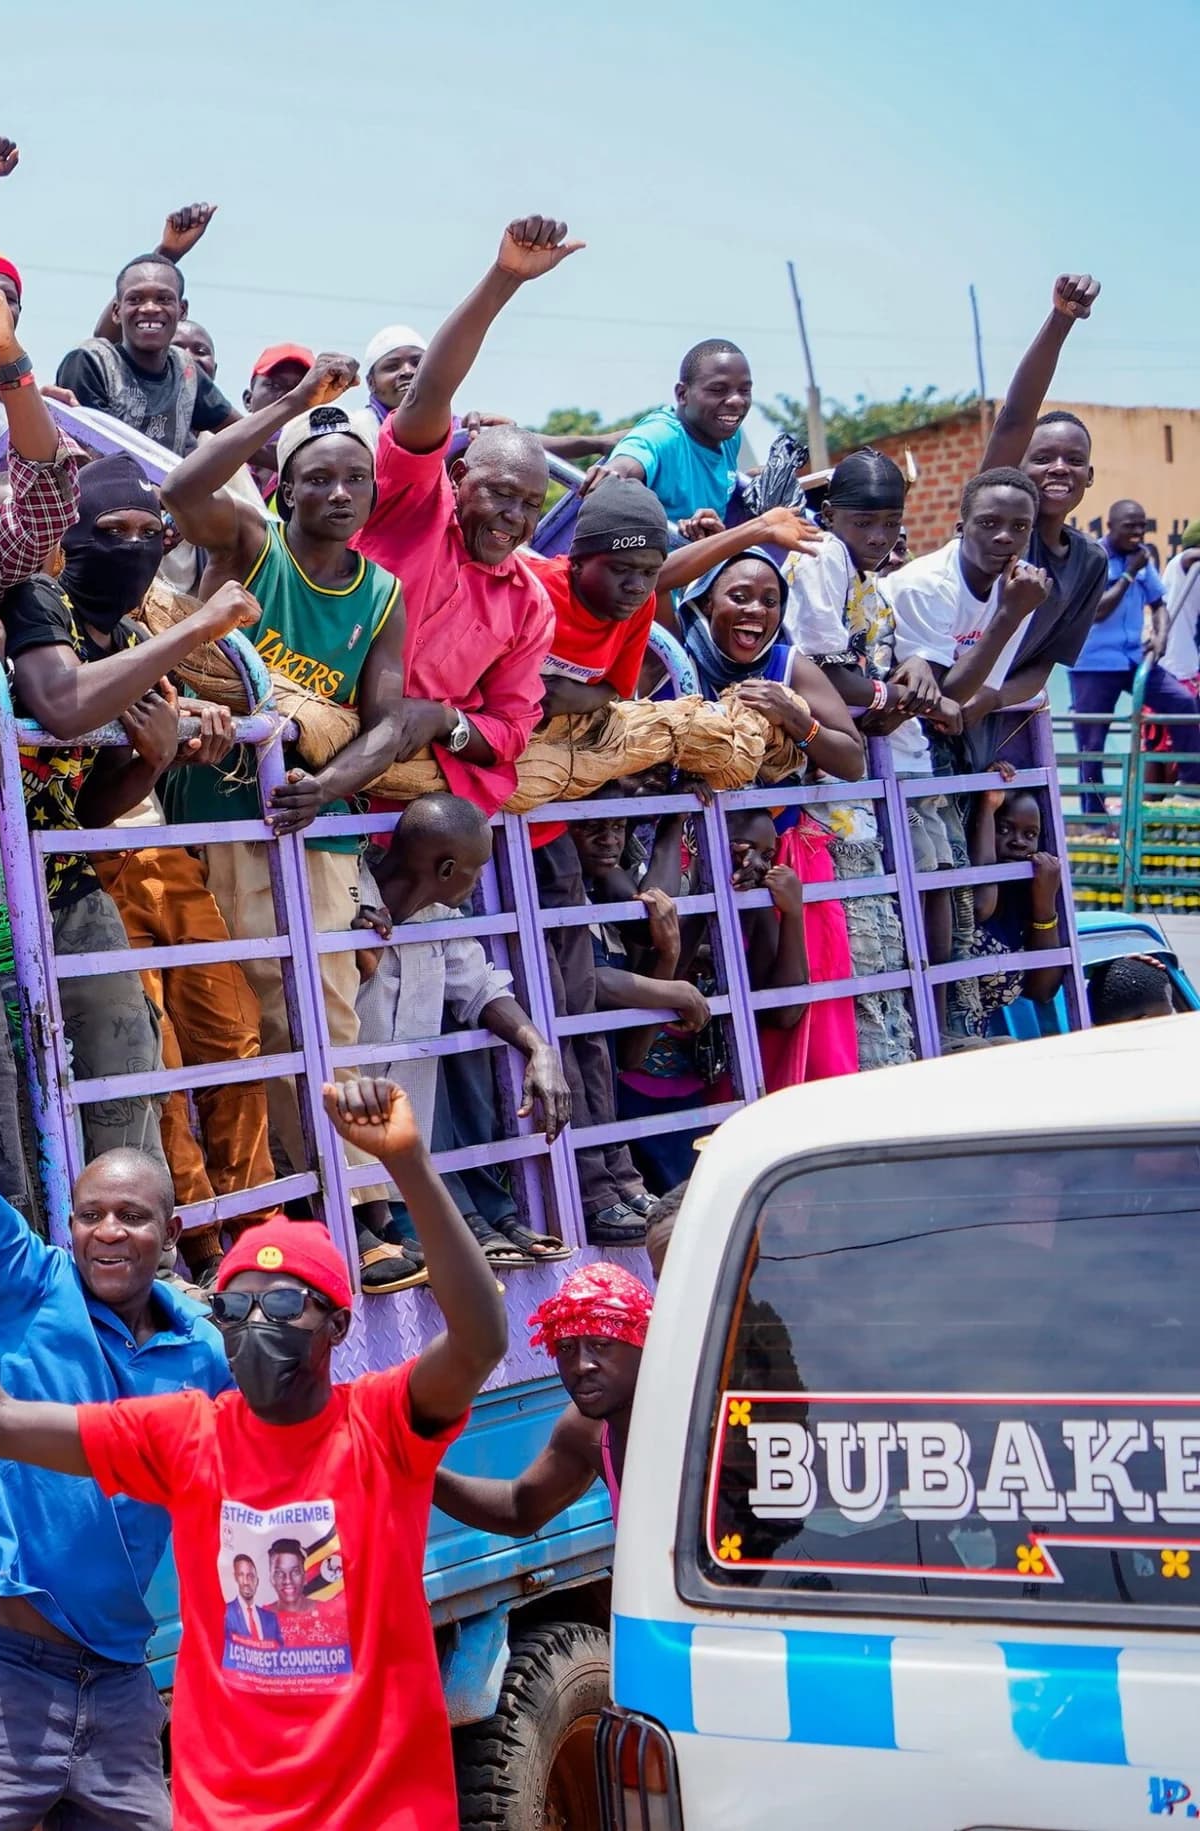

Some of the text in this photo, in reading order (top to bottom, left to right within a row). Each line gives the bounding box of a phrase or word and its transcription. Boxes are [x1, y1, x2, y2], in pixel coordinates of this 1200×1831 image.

[612, 535, 647, 550] 2025
[222, 1505, 331, 1527] STHER MIREMBE
[245, 1647, 278, 1668] DIRECT
[280, 1648, 346, 1667] COUNCILOR
